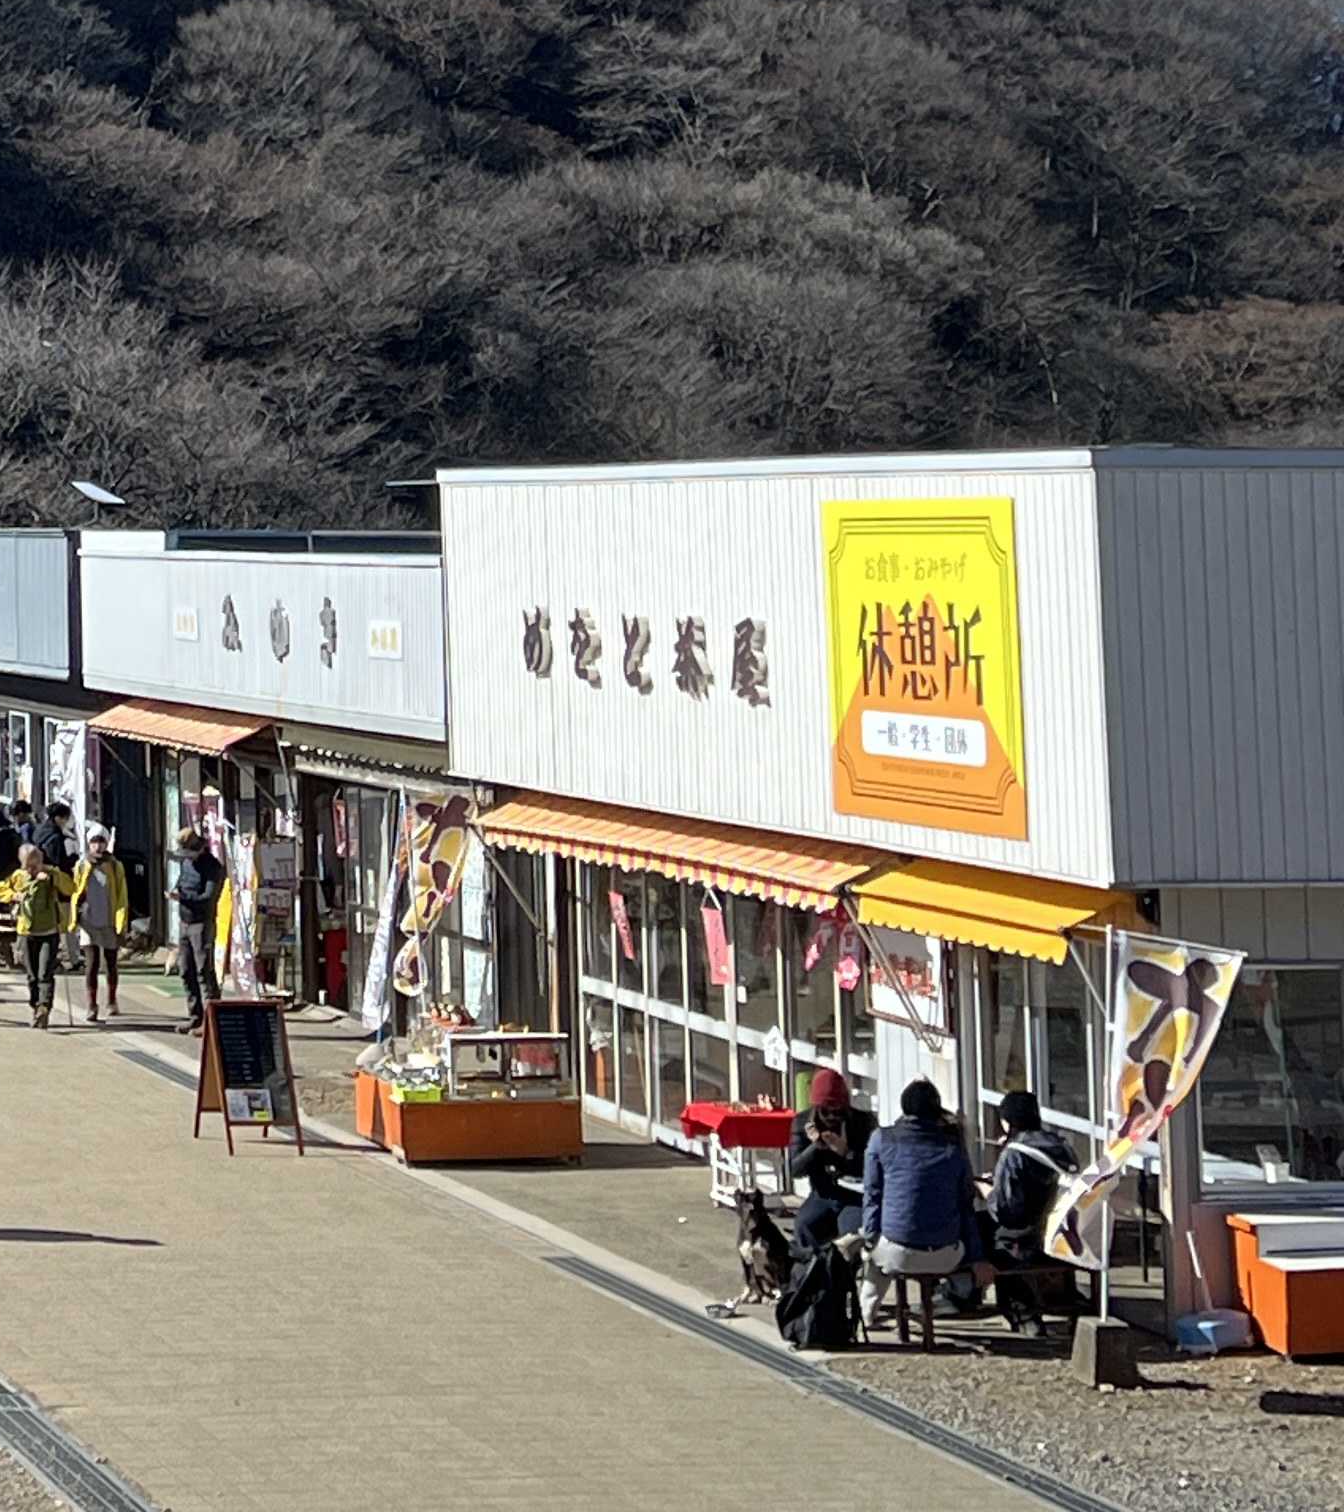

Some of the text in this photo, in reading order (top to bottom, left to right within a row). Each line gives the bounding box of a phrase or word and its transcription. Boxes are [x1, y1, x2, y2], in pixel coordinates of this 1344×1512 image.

[864, 551, 967, 583] お食事・おみやげ
[856, 599, 985, 706] 休憩所
